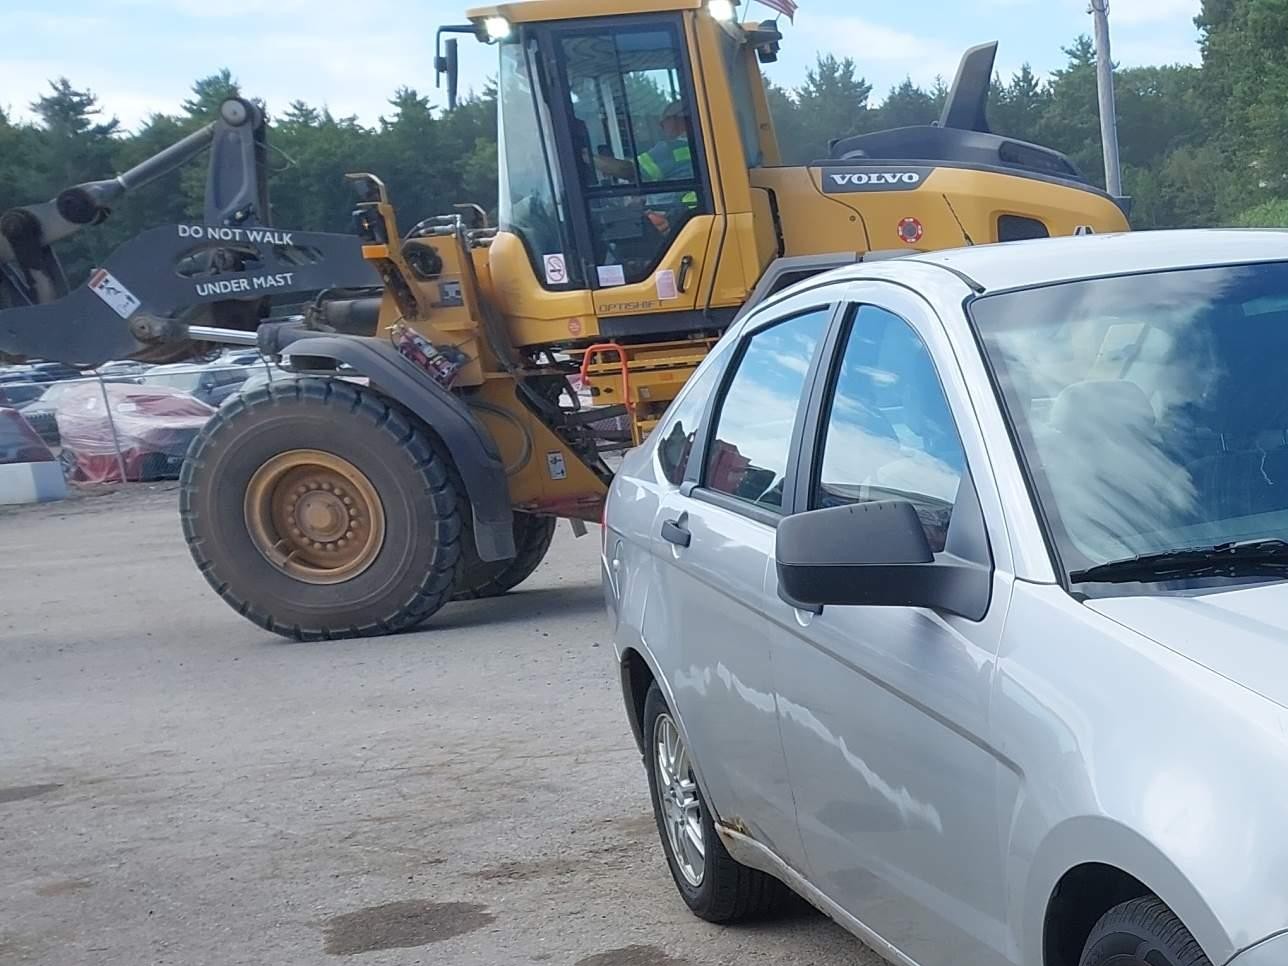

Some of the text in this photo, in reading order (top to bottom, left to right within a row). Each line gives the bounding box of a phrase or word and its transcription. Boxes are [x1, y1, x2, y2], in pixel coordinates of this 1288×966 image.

[830, 172, 920, 185] VOLVO
[178, 224, 294, 246] DO NOT WALK
[195, 272, 294, 296] UNDER MAST
